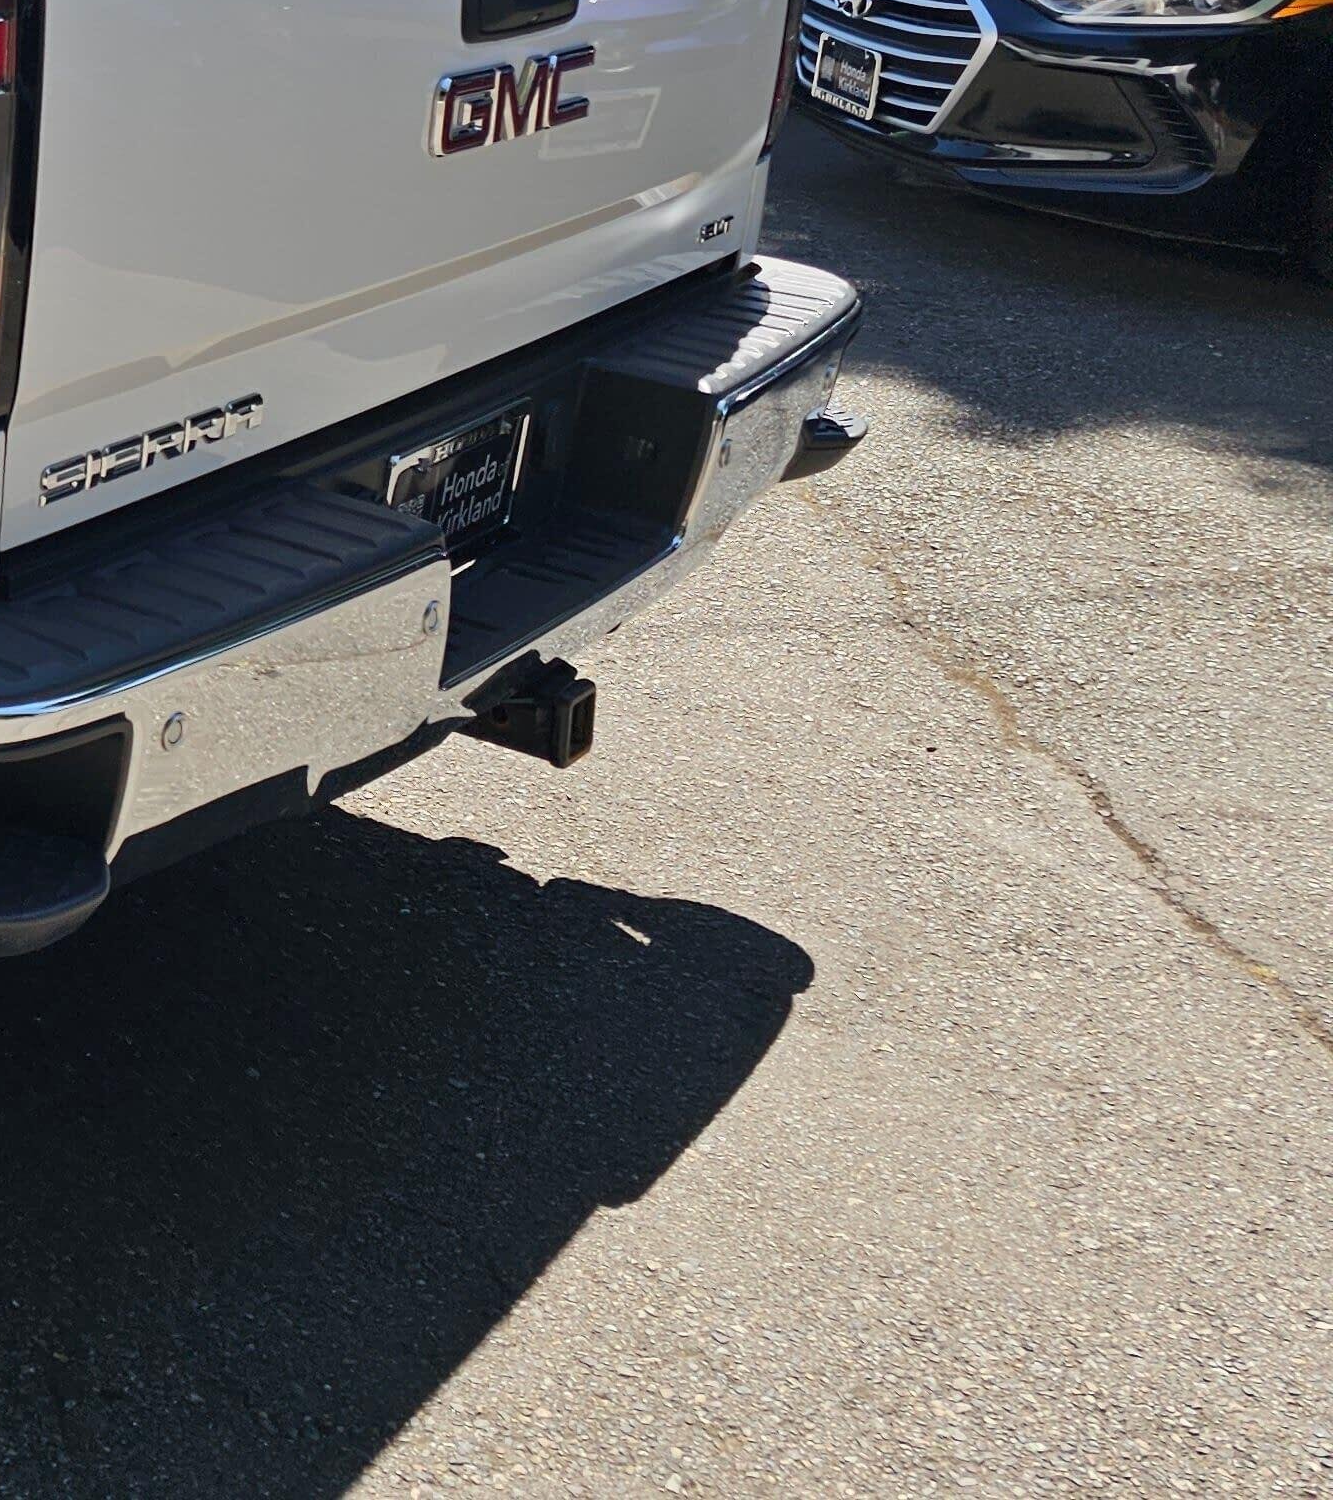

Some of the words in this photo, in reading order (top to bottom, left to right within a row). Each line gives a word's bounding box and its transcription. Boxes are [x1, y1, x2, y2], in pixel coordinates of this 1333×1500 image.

[839, 60, 867, 81] Honda
[426, 44, 596, 157] GMC
[815, 88, 867, 118] KIRKLAND
[39, 392, 264, 508] SIERRA
[436, 477, 506, 535] Kirkland
[440, 453, 498, 506] Honda
